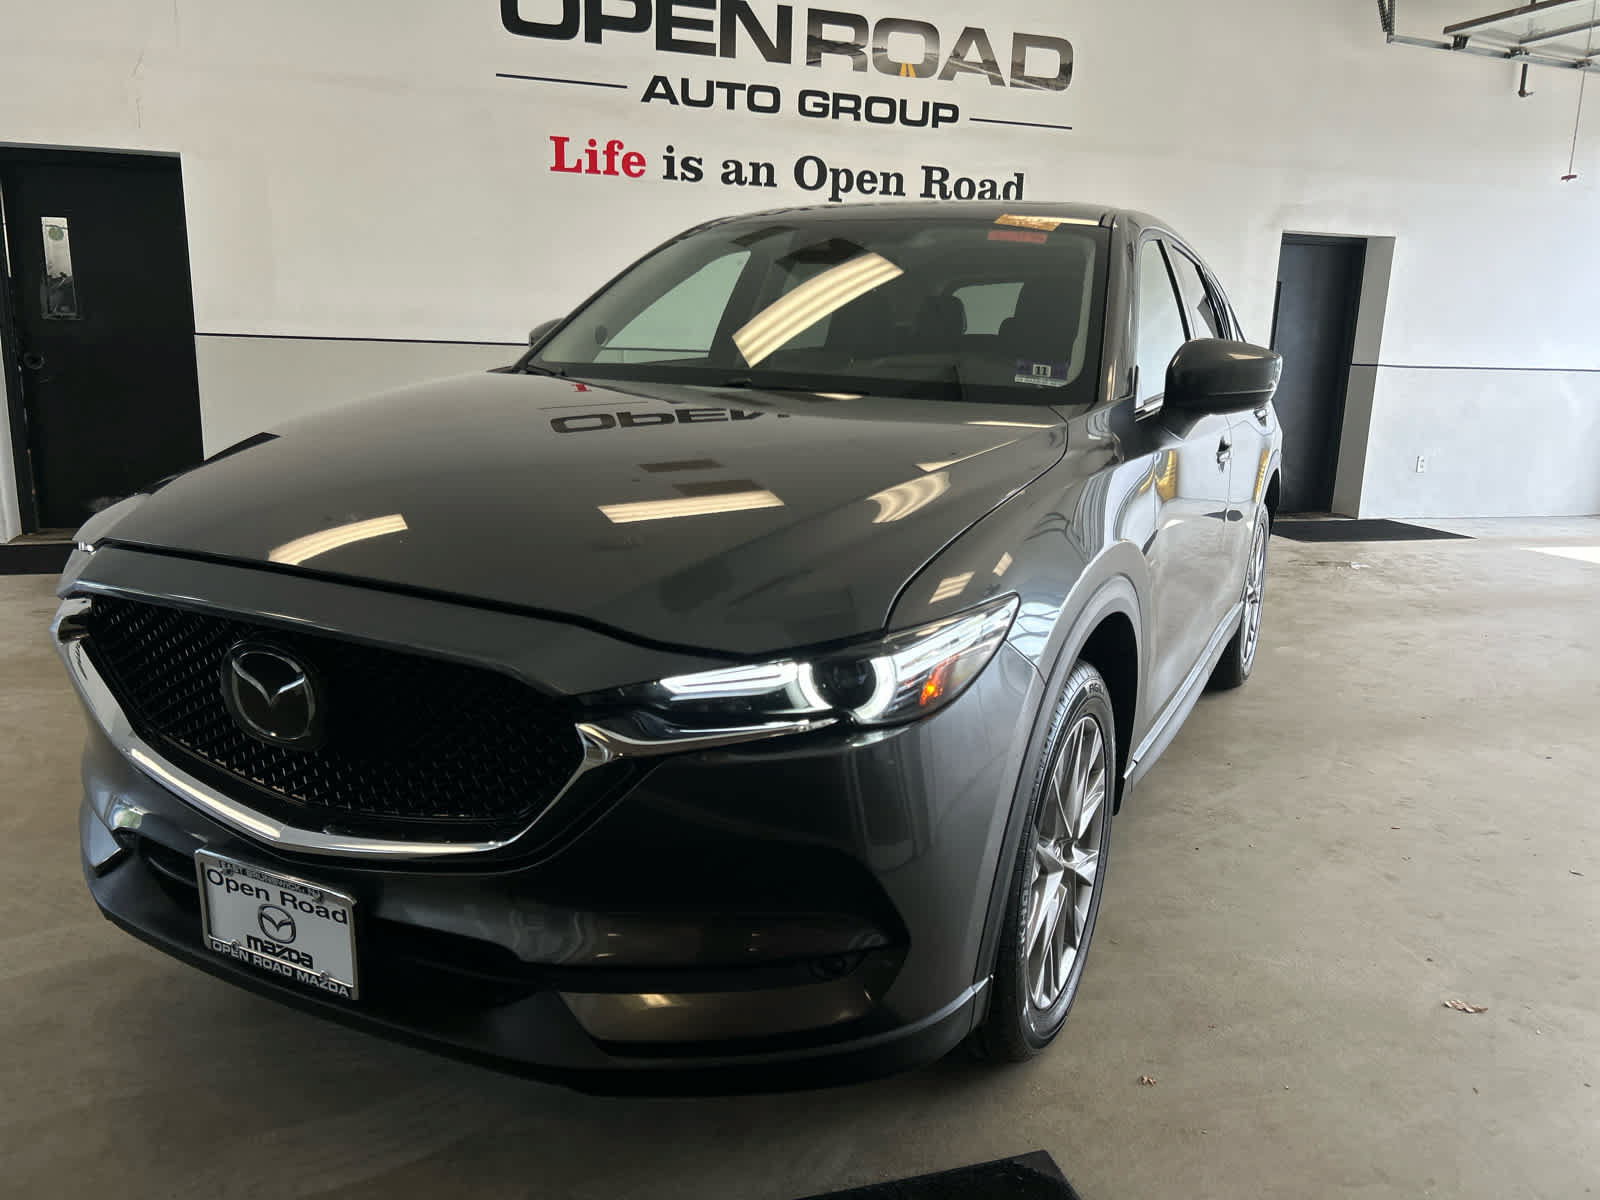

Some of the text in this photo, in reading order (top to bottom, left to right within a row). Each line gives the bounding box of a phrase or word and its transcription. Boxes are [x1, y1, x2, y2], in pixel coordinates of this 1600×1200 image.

[500, 0, 1074, 91] OPEN ROAD
[640, 75, 959, 128] AUTO GROUP
[549, 135, 1024, 202] Life is an Open Road
[207, 868, 270, 902] Open
[280, 890, 348, 925] Road
[212, 940, 350, 998] OPEN ROAD MAZDA
[246, 934, 314, 969] mazda
